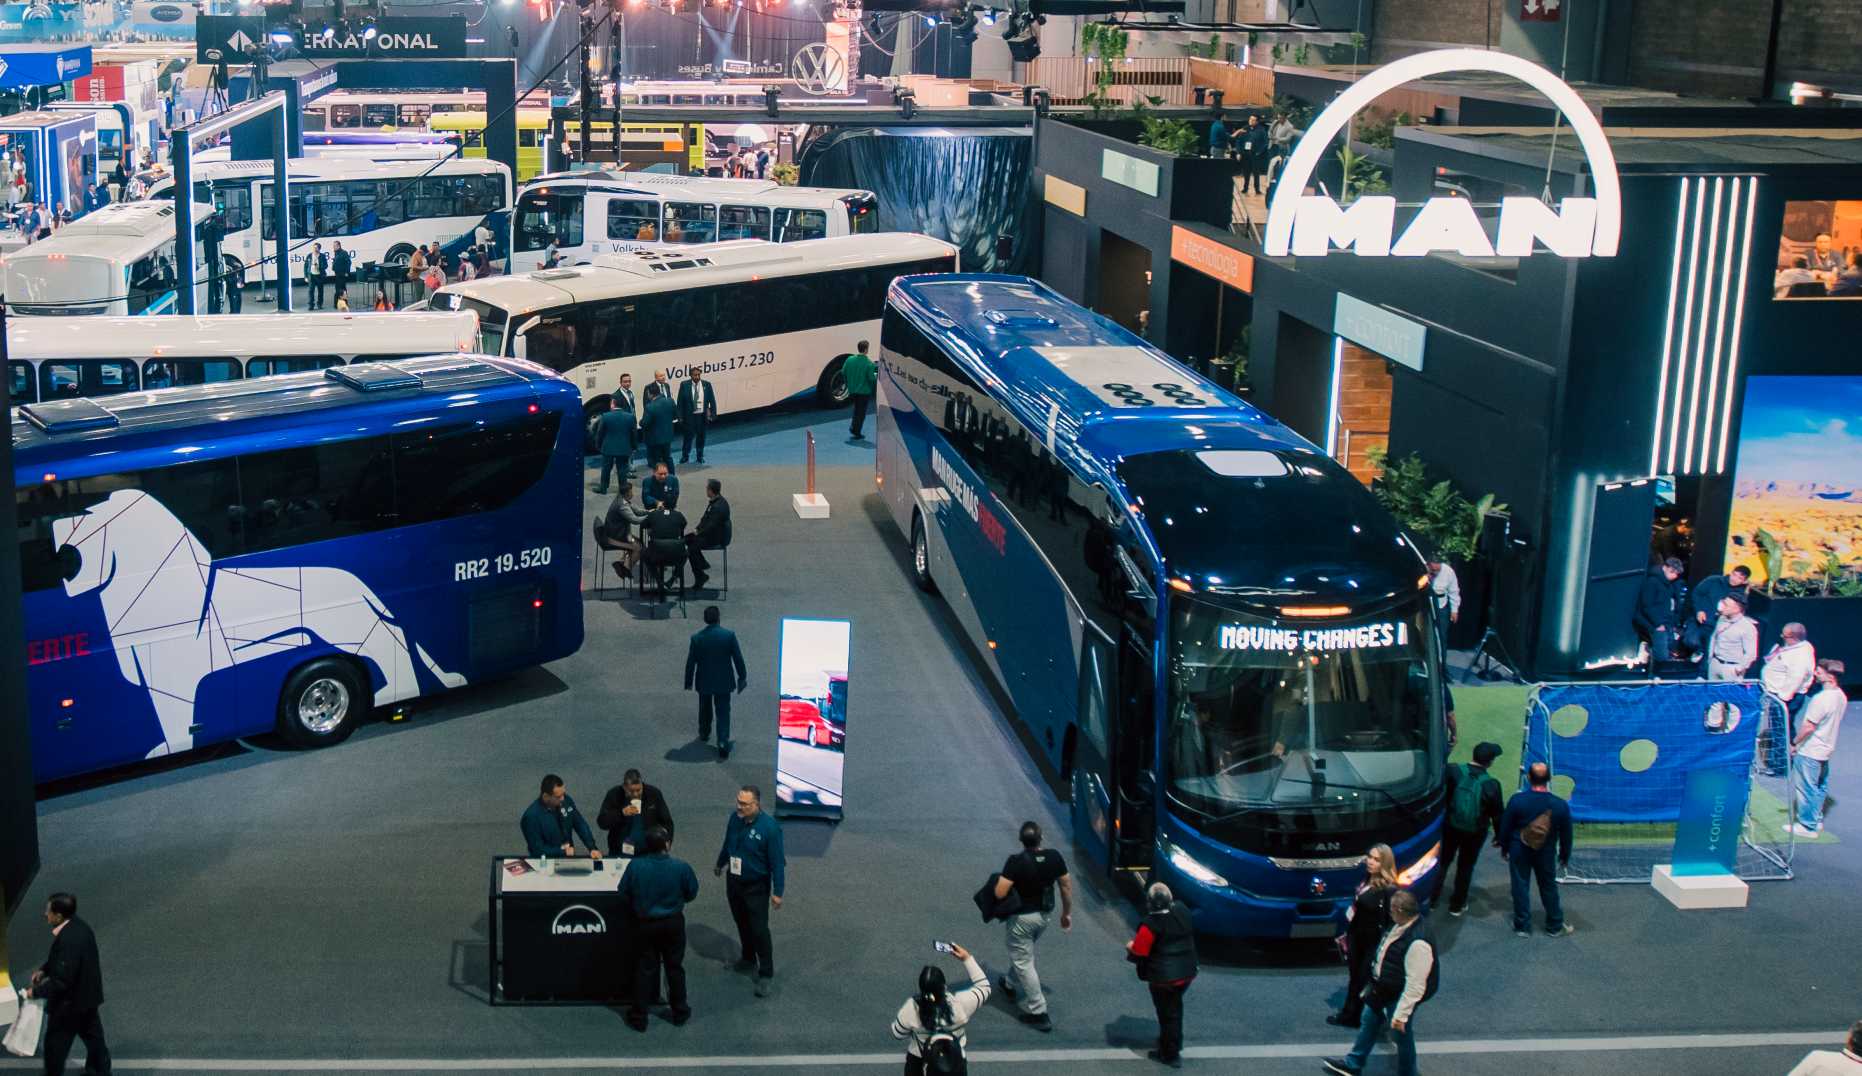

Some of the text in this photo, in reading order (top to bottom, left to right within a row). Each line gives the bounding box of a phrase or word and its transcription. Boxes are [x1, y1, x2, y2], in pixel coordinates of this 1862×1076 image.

[1291, 195, 1597, 257] MAN
[729, 351, 774, 370] 17.230
[455, 546, 552, 582] RR2 19.520
[1221, 625, 1298, 650] MOVING
[1303, 623, 1395, 651] CHANGES
[1708, 794, 1727, 853] +confort
[556, 923, 602, 935] MAN
